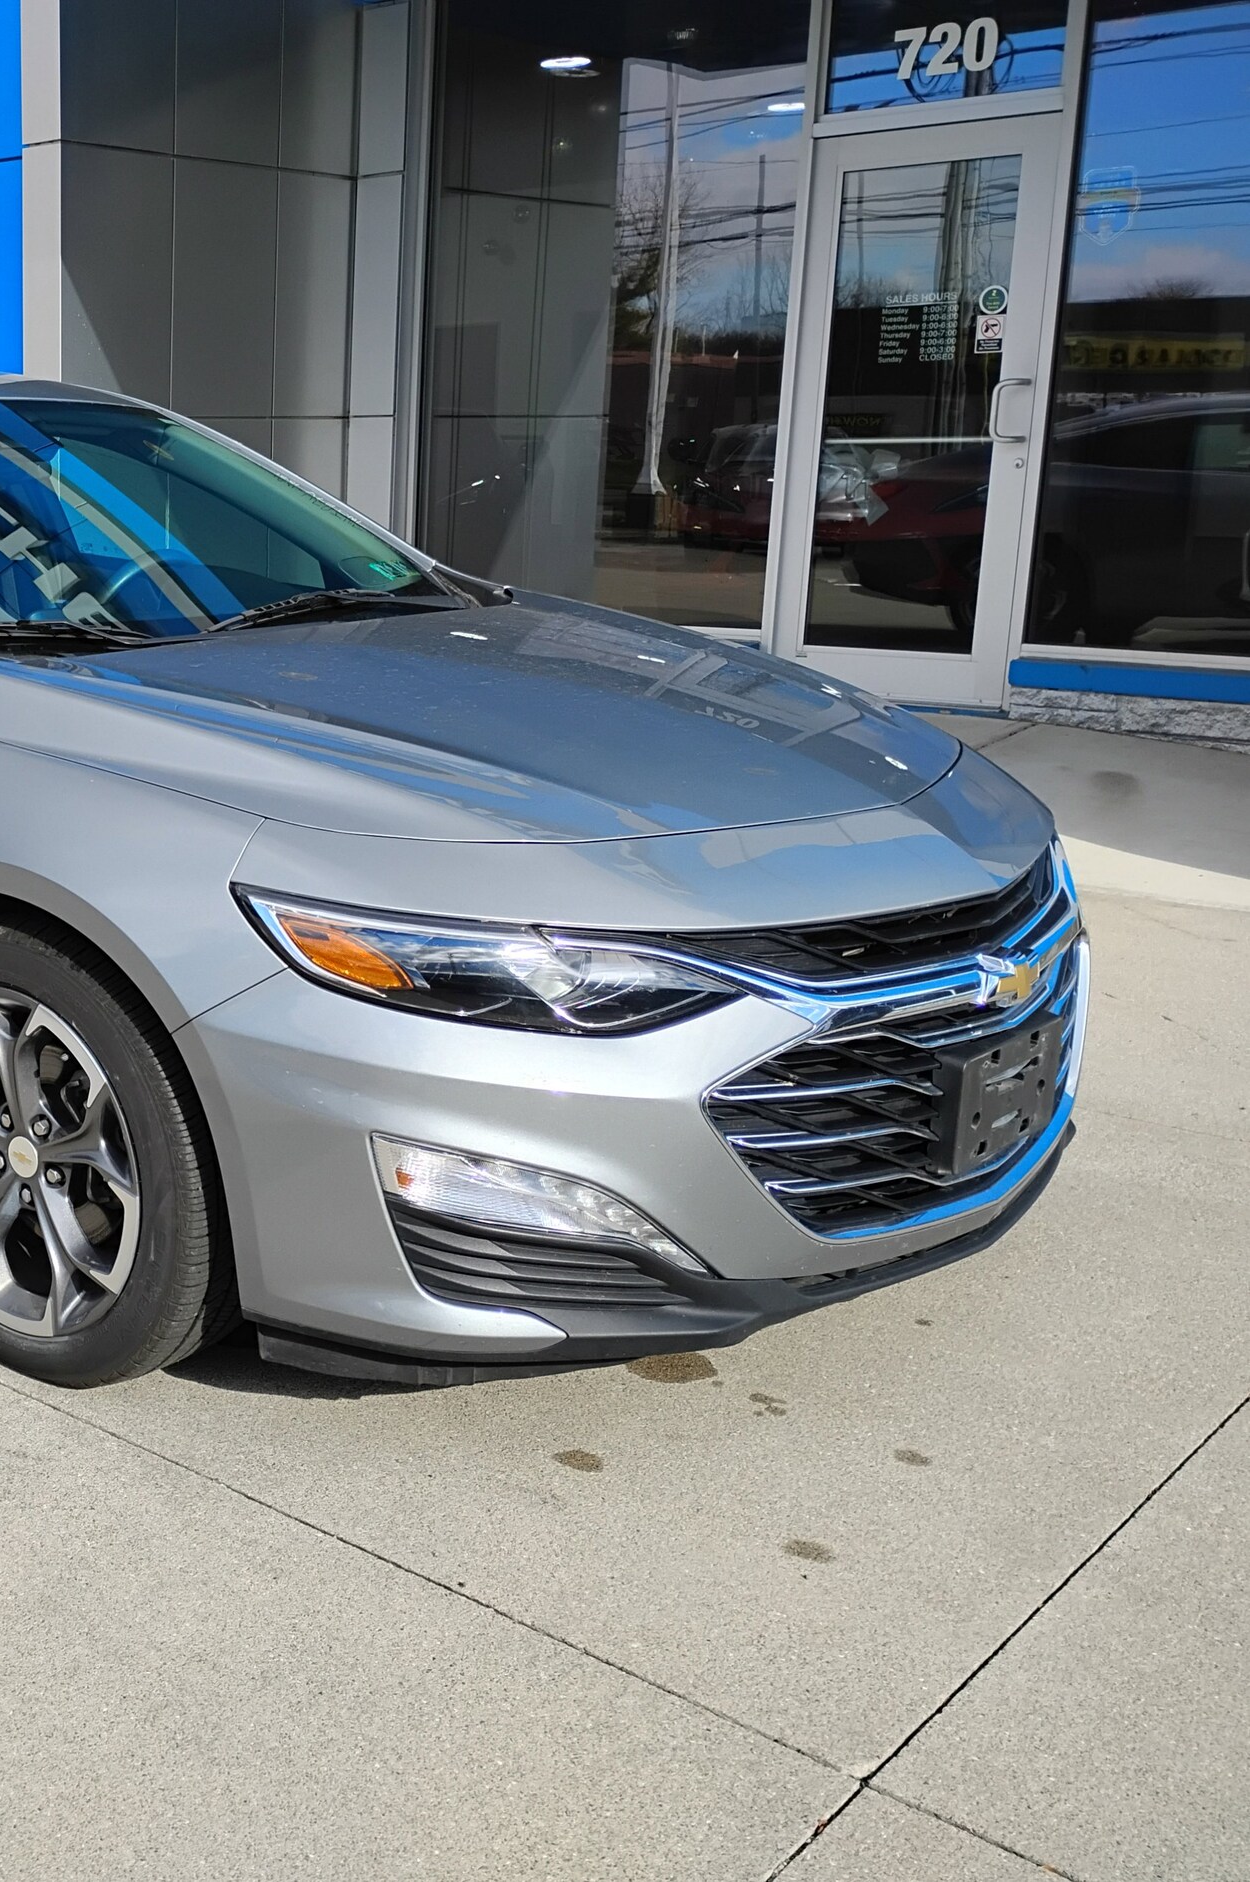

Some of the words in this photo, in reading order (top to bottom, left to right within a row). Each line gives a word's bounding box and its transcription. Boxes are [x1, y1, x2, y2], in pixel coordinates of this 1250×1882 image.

[894, 17, 999, 80] 720
[886, 294, 919, 304] SALES
[922, 291, 958, 302] HOURS
[880, 323, 920, 331] Wednesday
[879, 340, 901, 348] Friday
[918, 353, 954, 362] CLOSED
